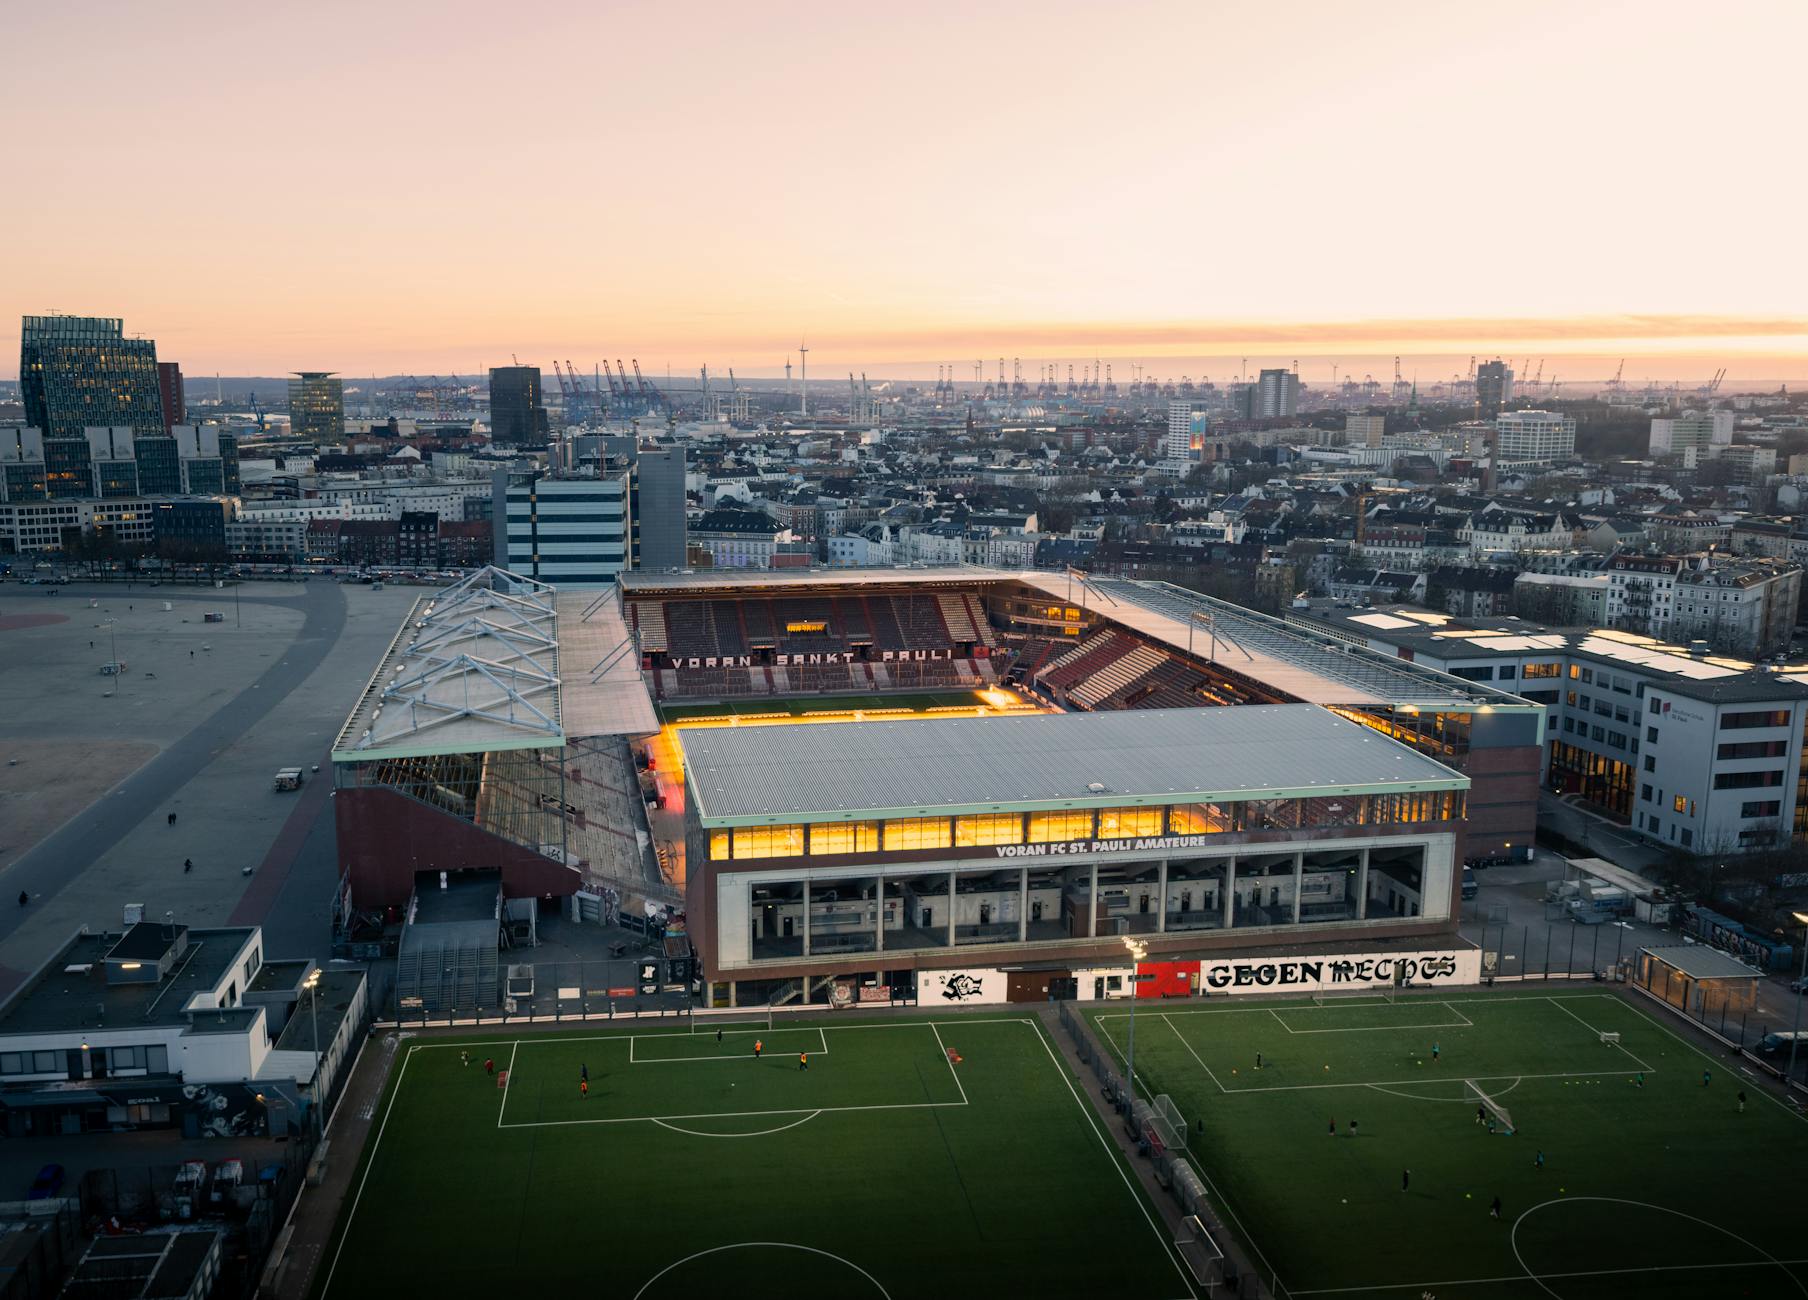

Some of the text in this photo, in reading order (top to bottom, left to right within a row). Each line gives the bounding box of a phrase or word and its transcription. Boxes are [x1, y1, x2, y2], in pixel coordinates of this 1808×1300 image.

[672, 649, 952, 669] VORAN SANKT PAULI
[996, 836, 1206, 857] VORAN FC ST. PAULI AMATEURE
[1206, 961, 1325, 988] GEGEN
